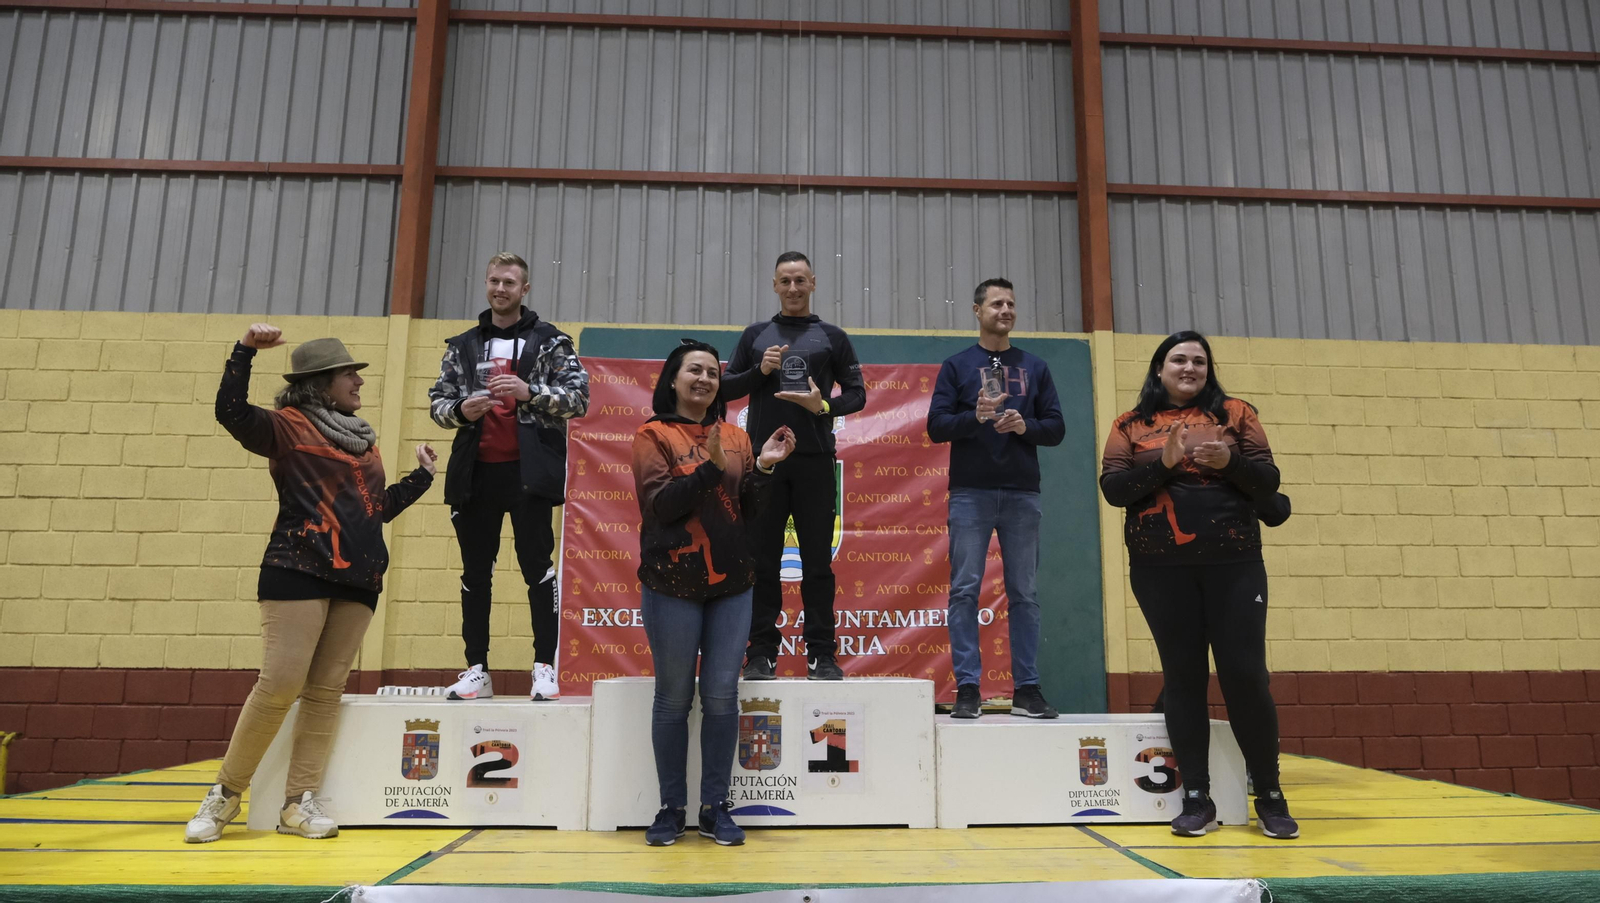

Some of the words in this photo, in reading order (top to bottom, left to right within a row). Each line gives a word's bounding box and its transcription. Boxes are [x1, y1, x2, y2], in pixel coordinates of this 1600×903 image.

[588, 374, 638, 386] NTORIA
[864, 381, 909, 390] NTORIA
[600, 405, 634, 416] AYTO.
[570, 430, 634, 441] CANTORIA
[847, 435, 911, 445] CANTORIA
[597, 462, 632, 474] AYTO.
[874, 466, 909, 477] AYTO.
[914, 466, 949, 477] CANT
[568, 489, 634, 501] CANTORIA
[846, 492, 911, 503] CANTORIA
[595, 522, 631, 533] AYTO.
[875, 525, 910, 535] AYTO.
[915, 524, 949, 535] CANT
[565, 548, 631, 560] CANTORIA
[847, 551, 912, 562] CANTORIA
[593, 582, 629, 593] AYTO.
[876, 584, 911, 595] AYTO.
[916, 583, 951, 594] CANT
[591, 643, 627, 654] AYTO.
[884, 644, 912, 655] YTO.
[917, 642, 951, 654] CANT
[808, 719, 859, 773] 1
[466, 740, 519, 789] 2
[1134, 747, 1183, 794] 3
[729, 774, 797, 787] IPUTACIÓN
[384, 785, 452, 796] DIPUTACIÓN
[740, 788, 795, 800] ALMERÍA
[1068, 788, 1120, 799] DIPUTACIÓN
[385, 798, 399, 807] DE
[402, 796, 449, 807] ALMERÍA
[1070, 799, 1083, 807] DE
[1084, 797, 1120, 807] ALMERÍA
